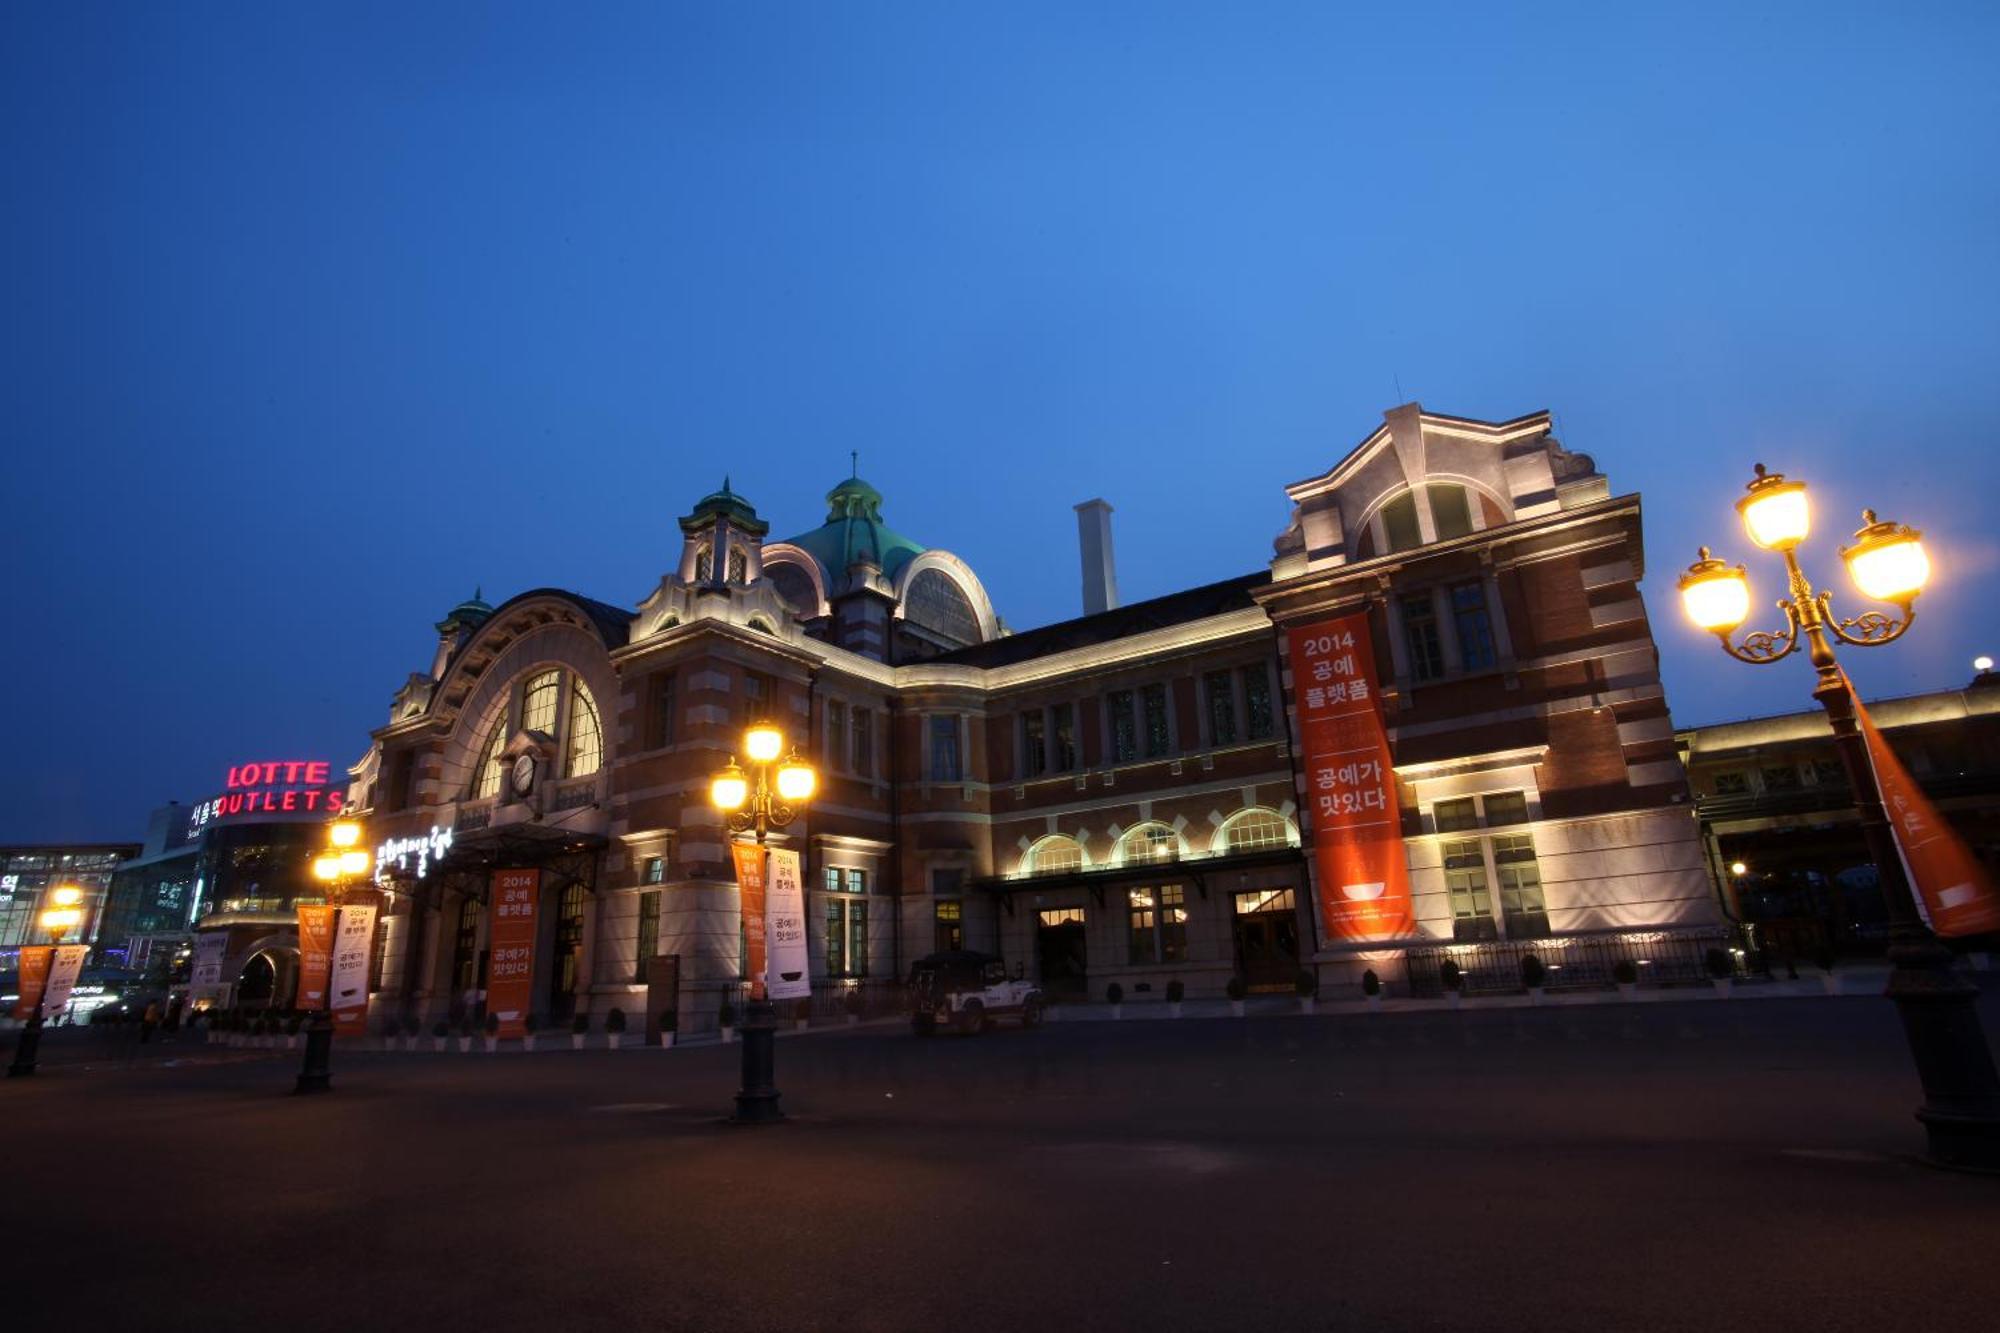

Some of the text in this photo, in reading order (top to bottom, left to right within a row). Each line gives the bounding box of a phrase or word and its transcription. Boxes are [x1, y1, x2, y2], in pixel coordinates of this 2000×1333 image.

[1304, 632, 1355, 657] 2014
[1312, 655, 1354, 681] 공예
[1305, 678, 1369, 709] 플랫폼
[228, 762, 329, 788] LOTTE
[1316, 760, 1382, 790] 공예가
[191, 800, 221, 826] 서울역
[218, 791, 343, 814] OUTLETS
[1318, 787, 1386, 818] 맛있다
[503, 876, 533, 888] 2014
[505, 889, 529, 901] 공예
[350, 909, 368, 917] 2014
[498, 904, 533, 917] 플랫폼
[494, 948, 530, 962] 공예가
[494, 962, 529, 977] 맛있다
